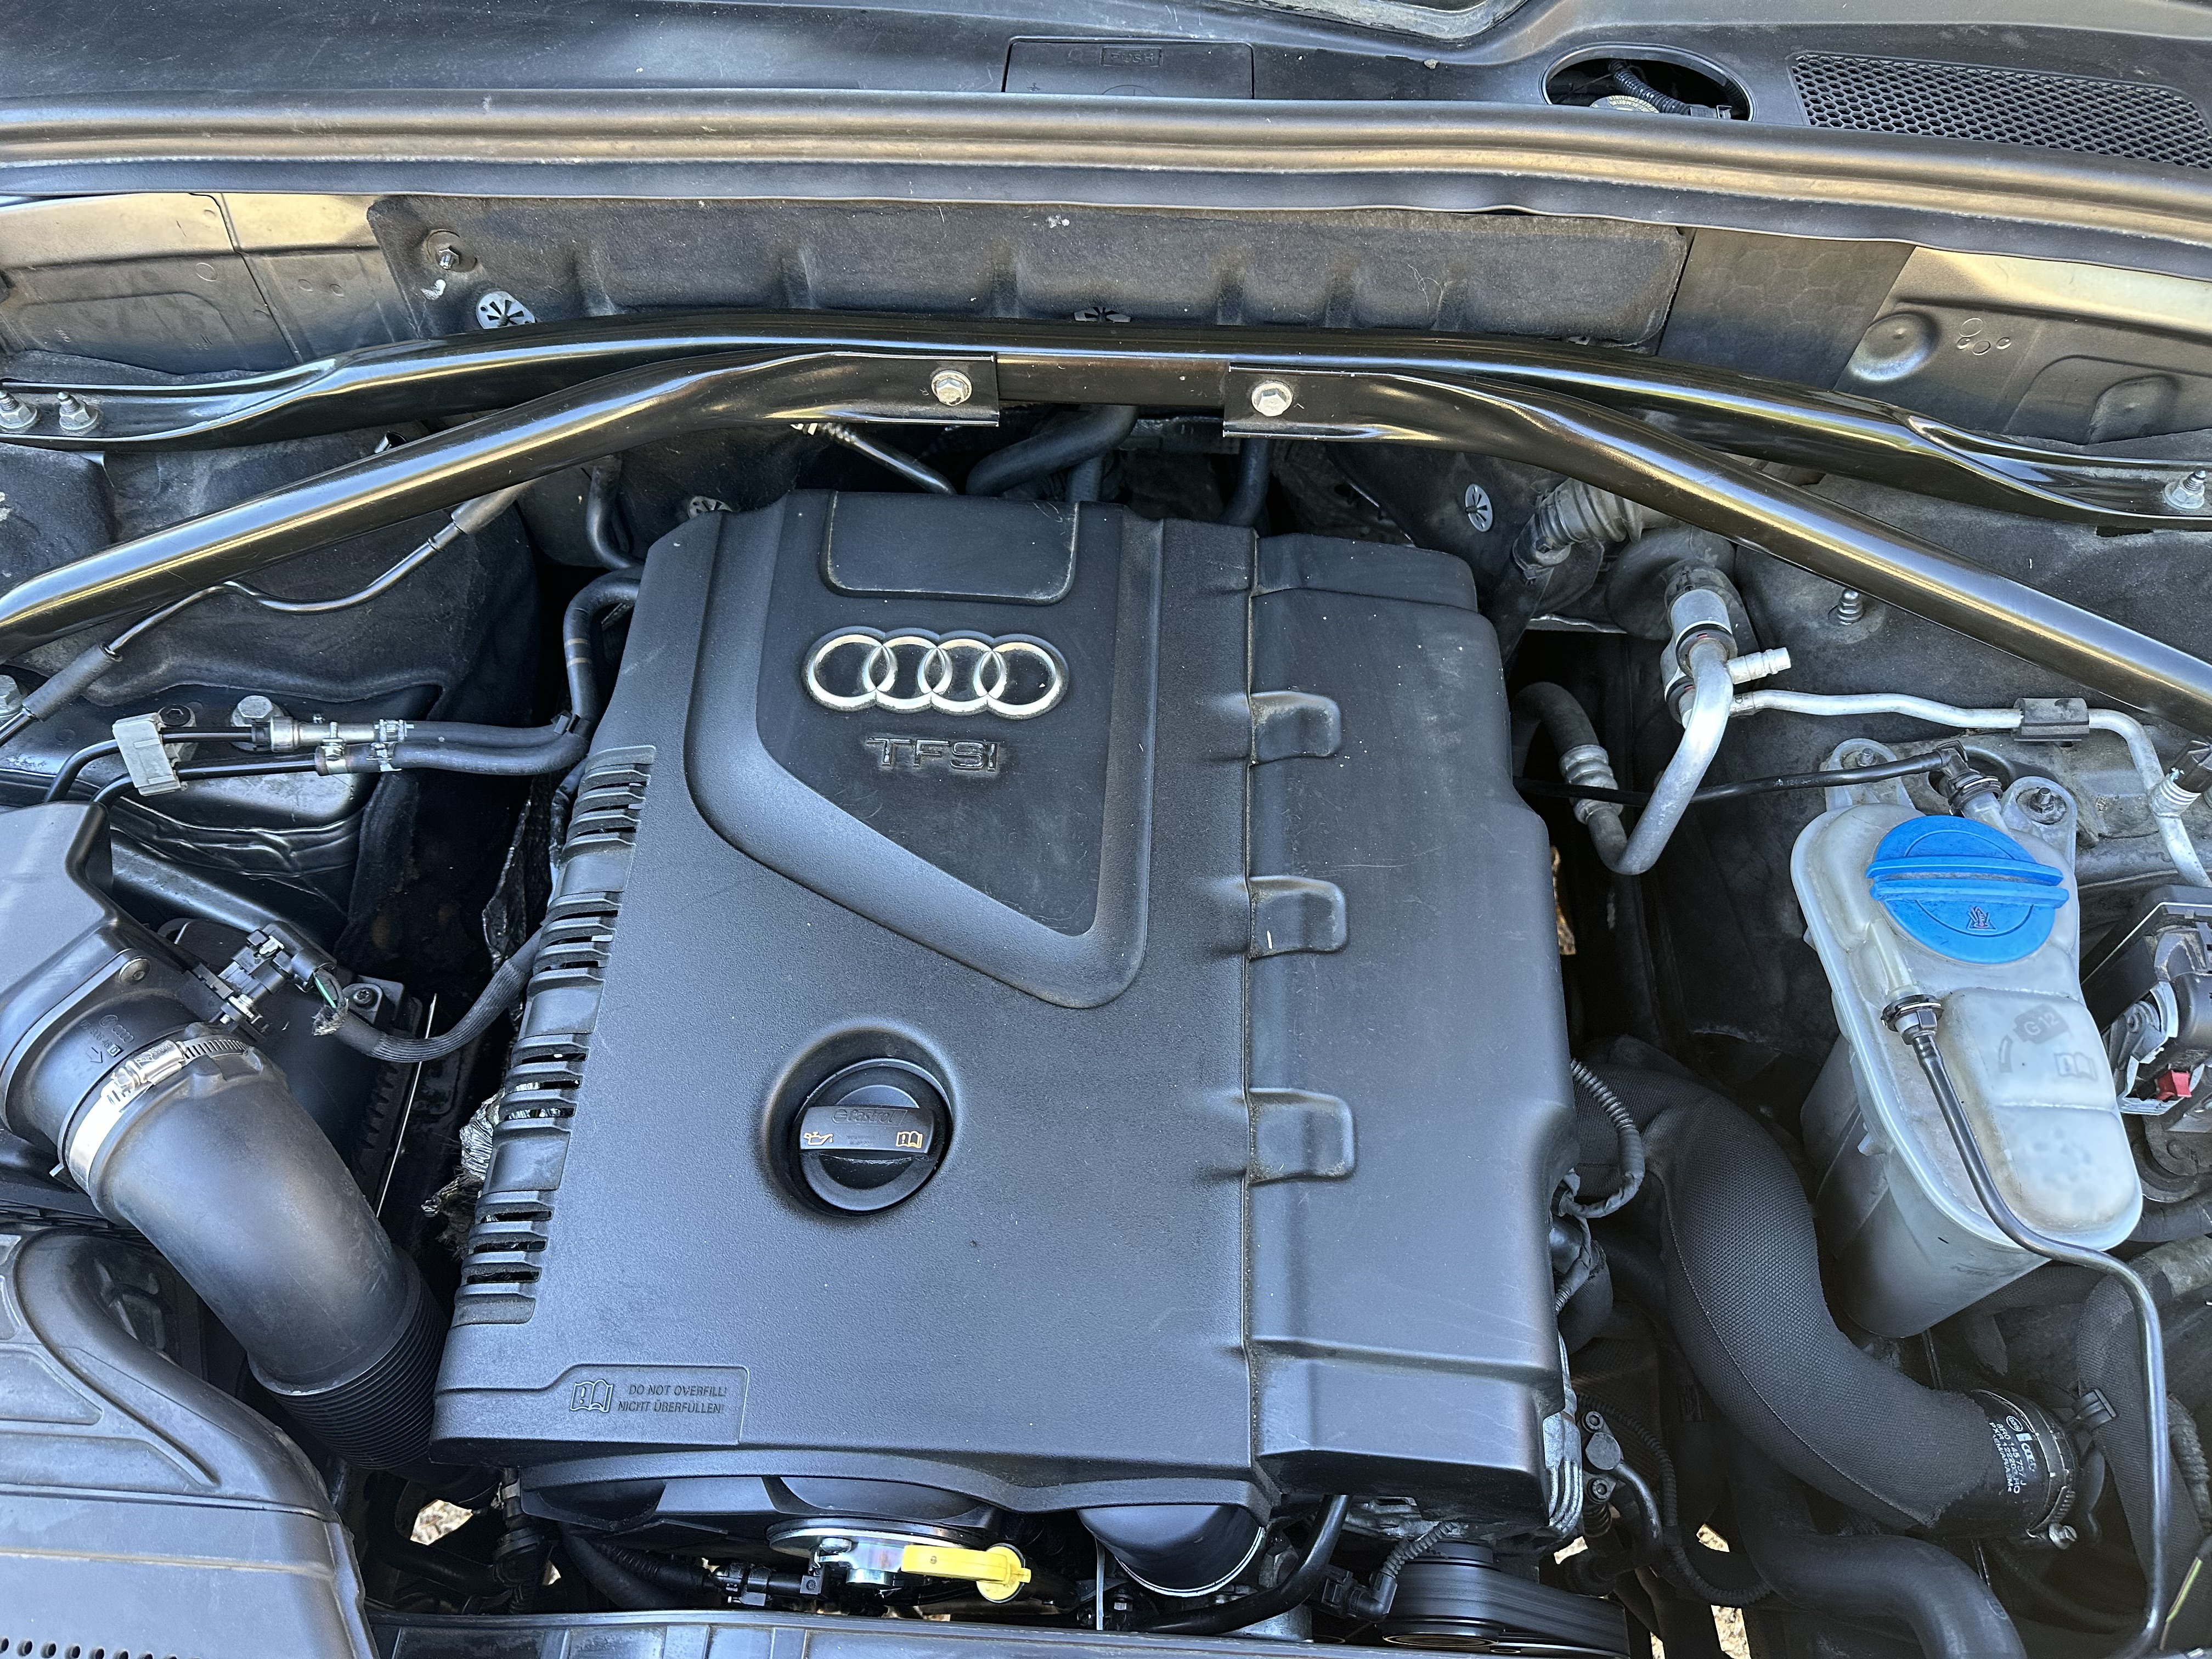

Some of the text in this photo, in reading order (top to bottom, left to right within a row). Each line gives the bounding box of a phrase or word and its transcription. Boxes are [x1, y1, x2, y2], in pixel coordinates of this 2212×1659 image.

[866, 737, 998, 772] TFSI
[846, 1109, 895, 1124] Castrol
[629, 1384, 727, 1397] DO NOT OVERFILL!
[618, 1401, 650, 1412] NICHT
[2008, 1442, 2021, 1458] 145
